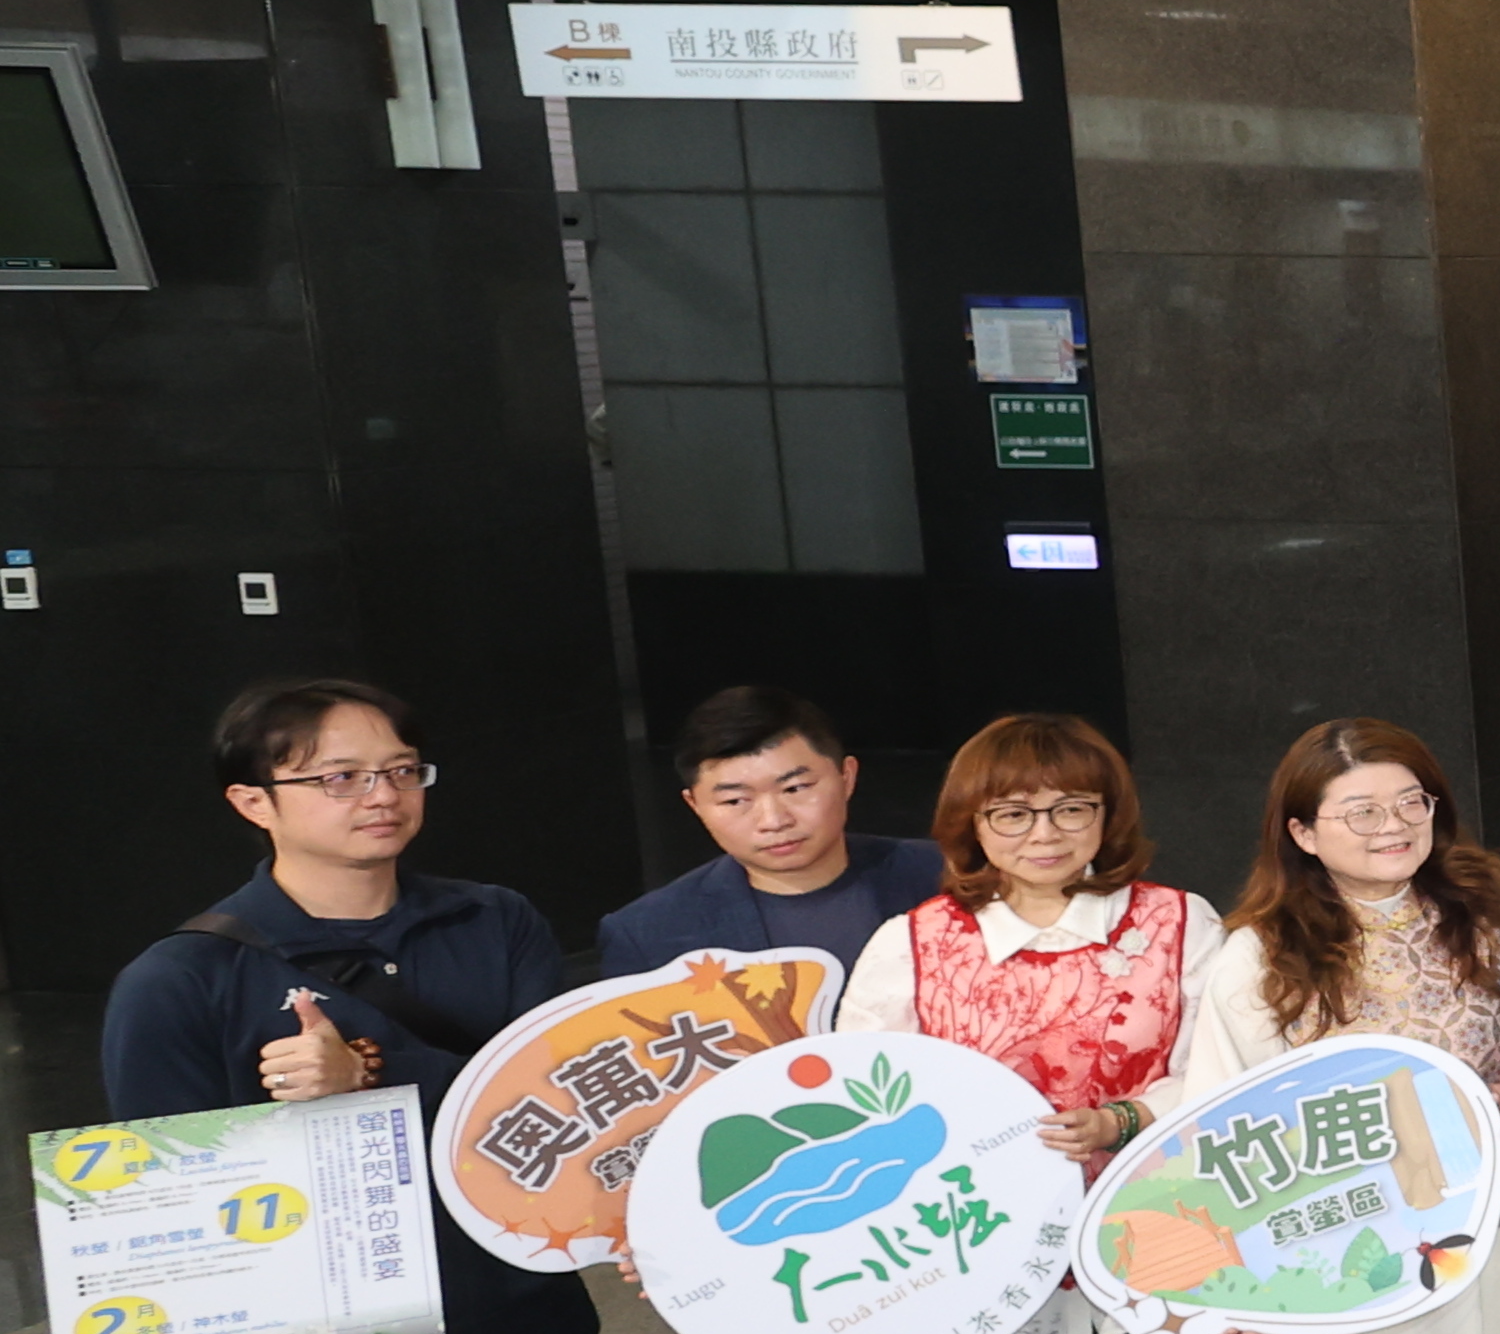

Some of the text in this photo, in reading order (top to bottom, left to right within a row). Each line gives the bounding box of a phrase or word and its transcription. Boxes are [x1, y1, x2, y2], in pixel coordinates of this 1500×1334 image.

[666, 27, 860, 60] 南投縣政府
[478, 1013, 742, 1191] 奧萬大
[69, 1140, 111, 1182] 7
[1195, 1084, 1395, 1208] 竹鹿
[219, 1192, 280, 1236] 11
[356, 1109, 406, 1283] 螢光閃舞的盛宴
[1267, 1182, 1388, 1247] 賞螢區
